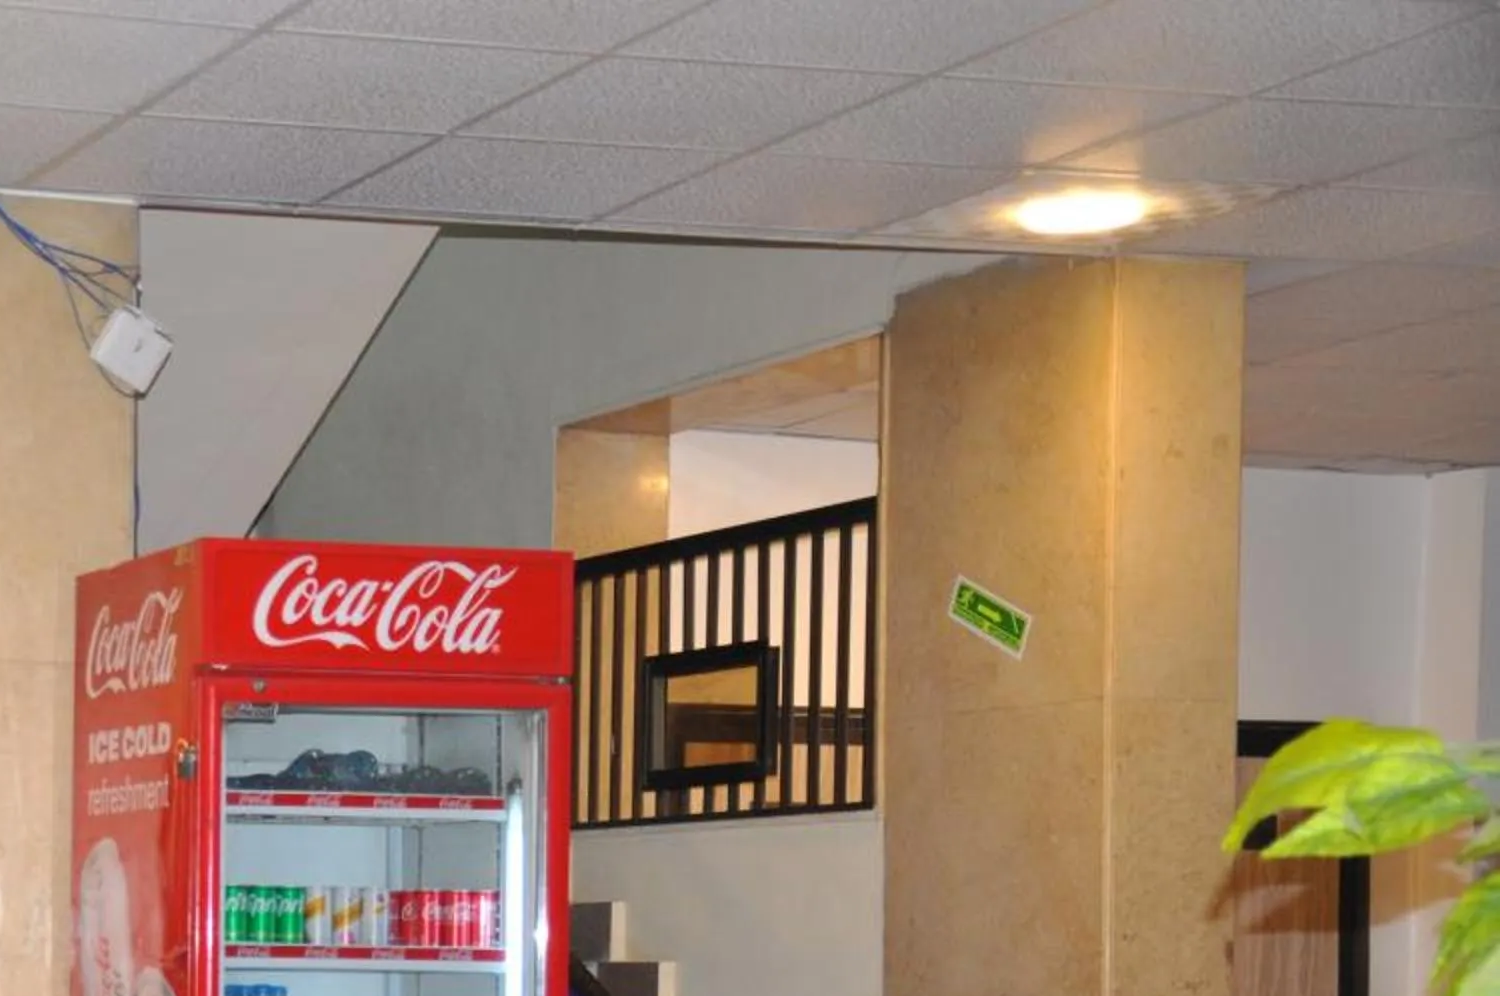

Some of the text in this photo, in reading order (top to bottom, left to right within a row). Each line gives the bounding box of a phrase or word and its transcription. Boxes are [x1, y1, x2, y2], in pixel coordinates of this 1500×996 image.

[253, 554, 518, 654] Coca-Cola
[86, 587, 183, 699] Coca-Cola
[89, 721, 171, 764] ICE COLD
[87, 773, 170, 817] refreshment
